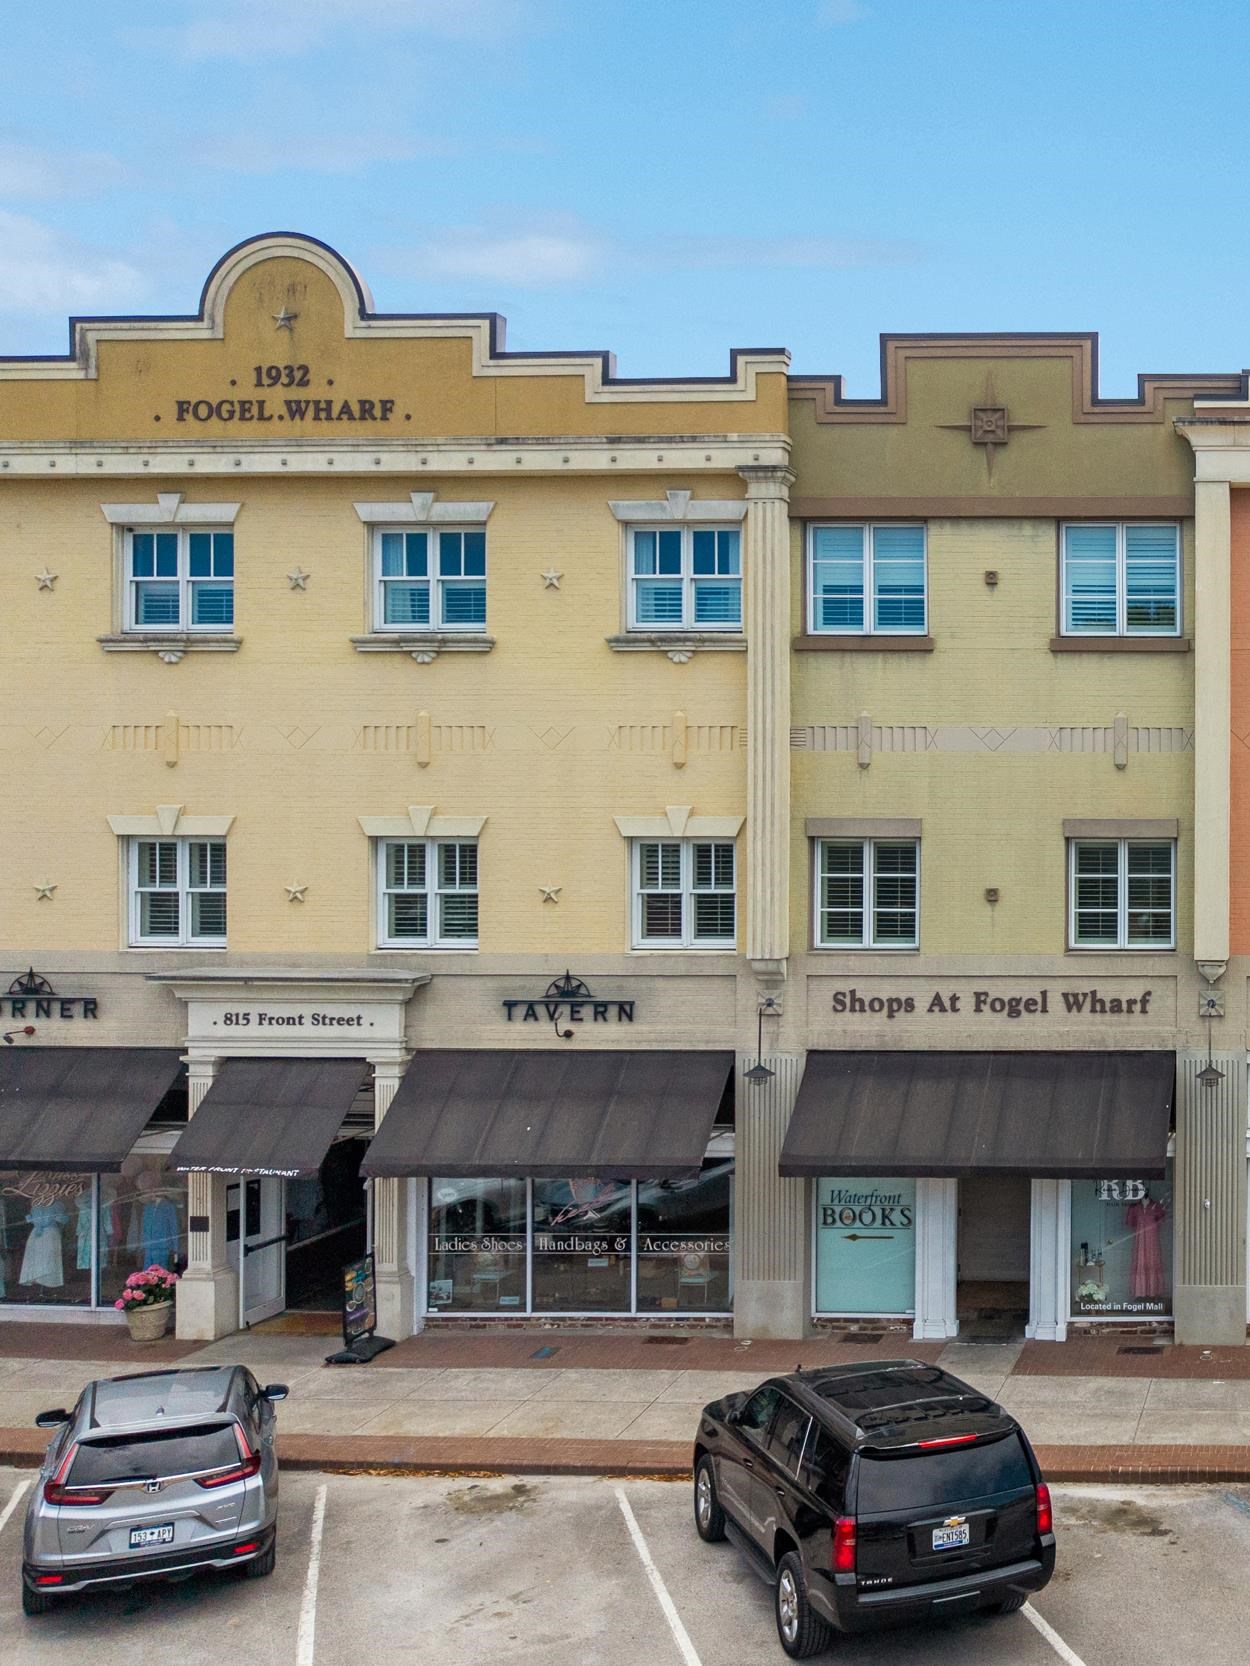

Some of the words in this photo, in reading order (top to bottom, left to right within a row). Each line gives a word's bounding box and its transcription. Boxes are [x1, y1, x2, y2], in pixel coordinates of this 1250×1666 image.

[254, 364, 311, 388] 1932
[0, 999, 98, 1019] RNER
[503, 1001, 634, 1022] TAVERN
[832, 989, 915, 1018] Shops
[927, 992, 961, 1013] At
[973, 990, 1049, 1018] Fogel
[1061, 990, 1152, 1014] Wharf
[223, 1012, 251, 1026] 815
[257, 1013, 304, 1026] Front
[311, 1013, 363, 1026] Street
[1, 1171, 84, 1208] Lizzies
[830, 1189, 902, 1208] Waterfront
[822, 1207, 912, 1227] BOOKS
[435, 1236, 478, 1251] Ladies
[480, 1236, 523, 1251] Shoes
[539, 1236, 608, 1255] Handbags
[614, 1237, 627, 1250] &
[643, 1237, 731, 1251] Accessories
[1081, 1302, 1112, 1310] Located
[1113, 1302, 1121, 1310] in
[1122, 1302, 1145, 1311] Fogel
[1146, 1302, 1164, 1310] Mall
[133, 1531, 147, 1542] 153
[861, 1577, 893, 1585] TAHOE
